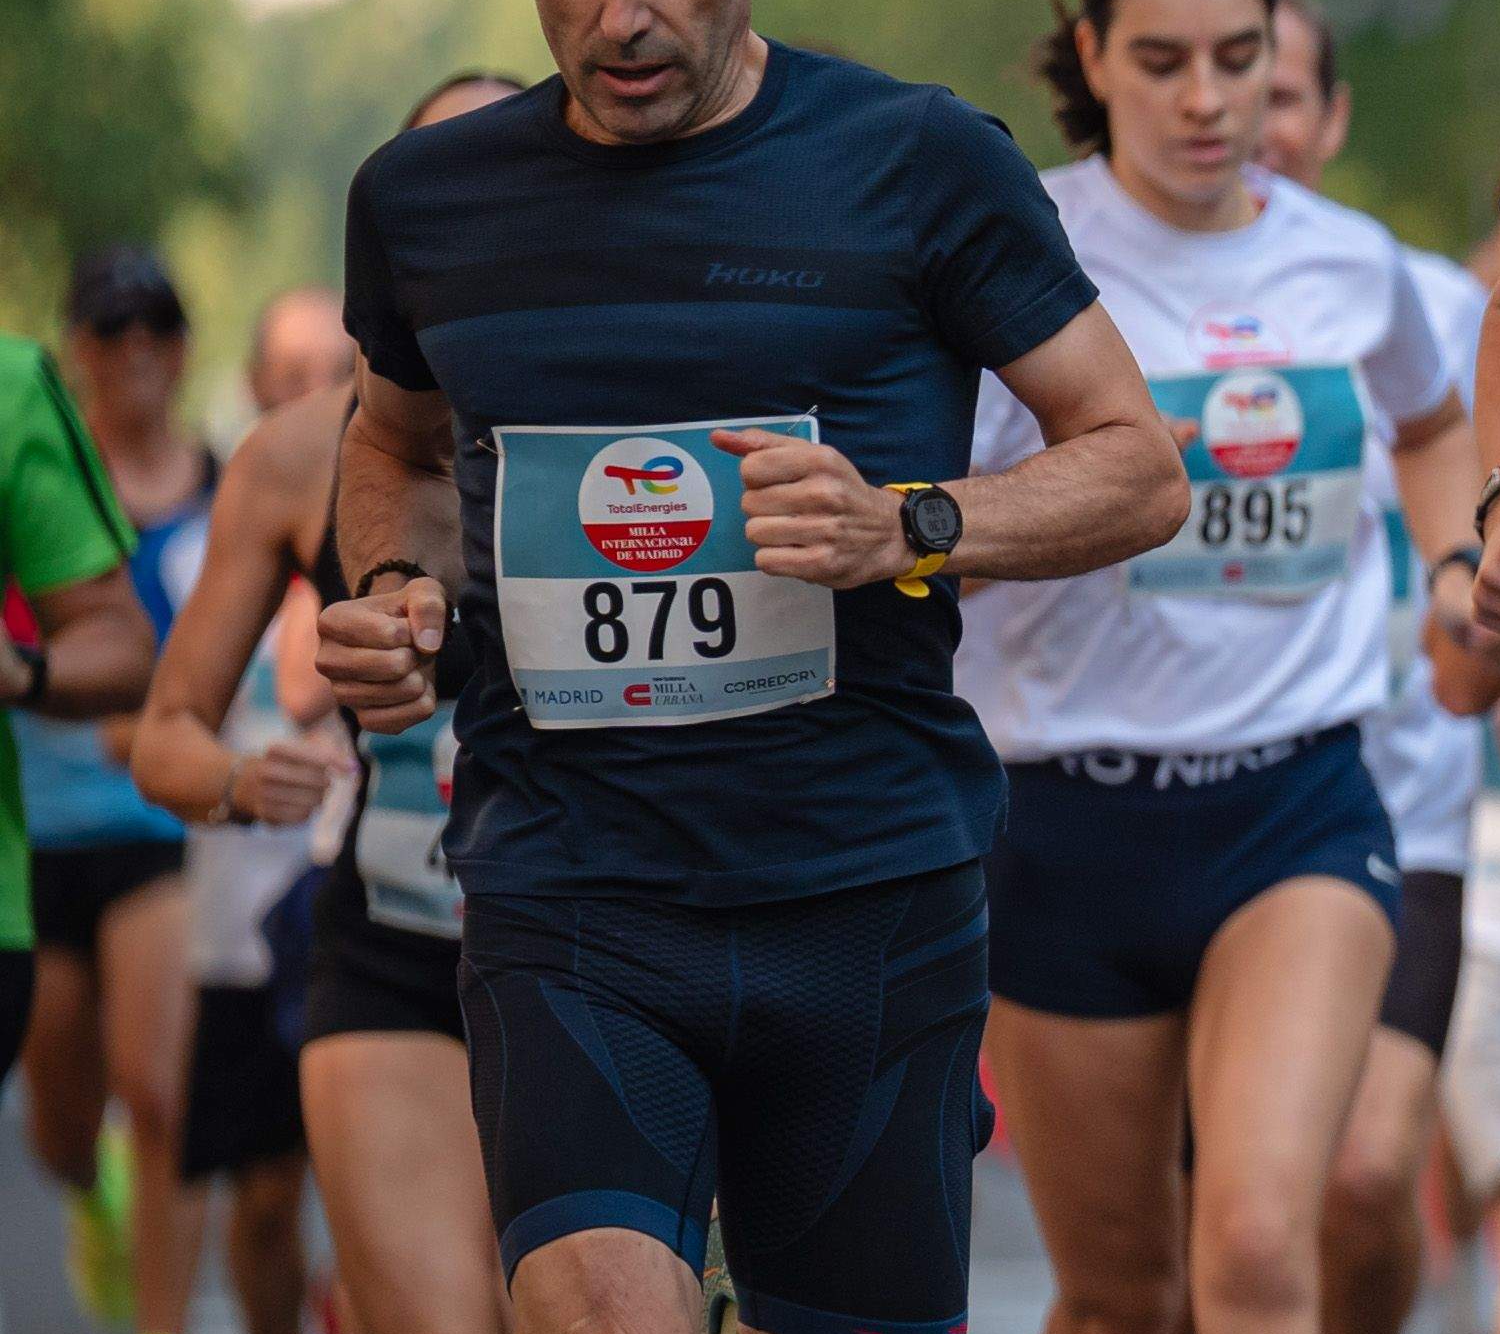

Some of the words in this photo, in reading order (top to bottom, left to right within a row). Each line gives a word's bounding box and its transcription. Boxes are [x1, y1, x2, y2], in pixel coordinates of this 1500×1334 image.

[606, 502, 688, 515] TotalEnergies
[1201, 481, 1310, 545] 895
[629, 527, 667, 536] MILLA
[616, 551, 633, 561] DE
[636, 549, 683, 560] MADRID
[583, 577, 737, 664] 879
[653, 682, 697, 694] MILLA
[534, 689, 604, 705] MADRID
[653, 693, 705, 706] URBANA
